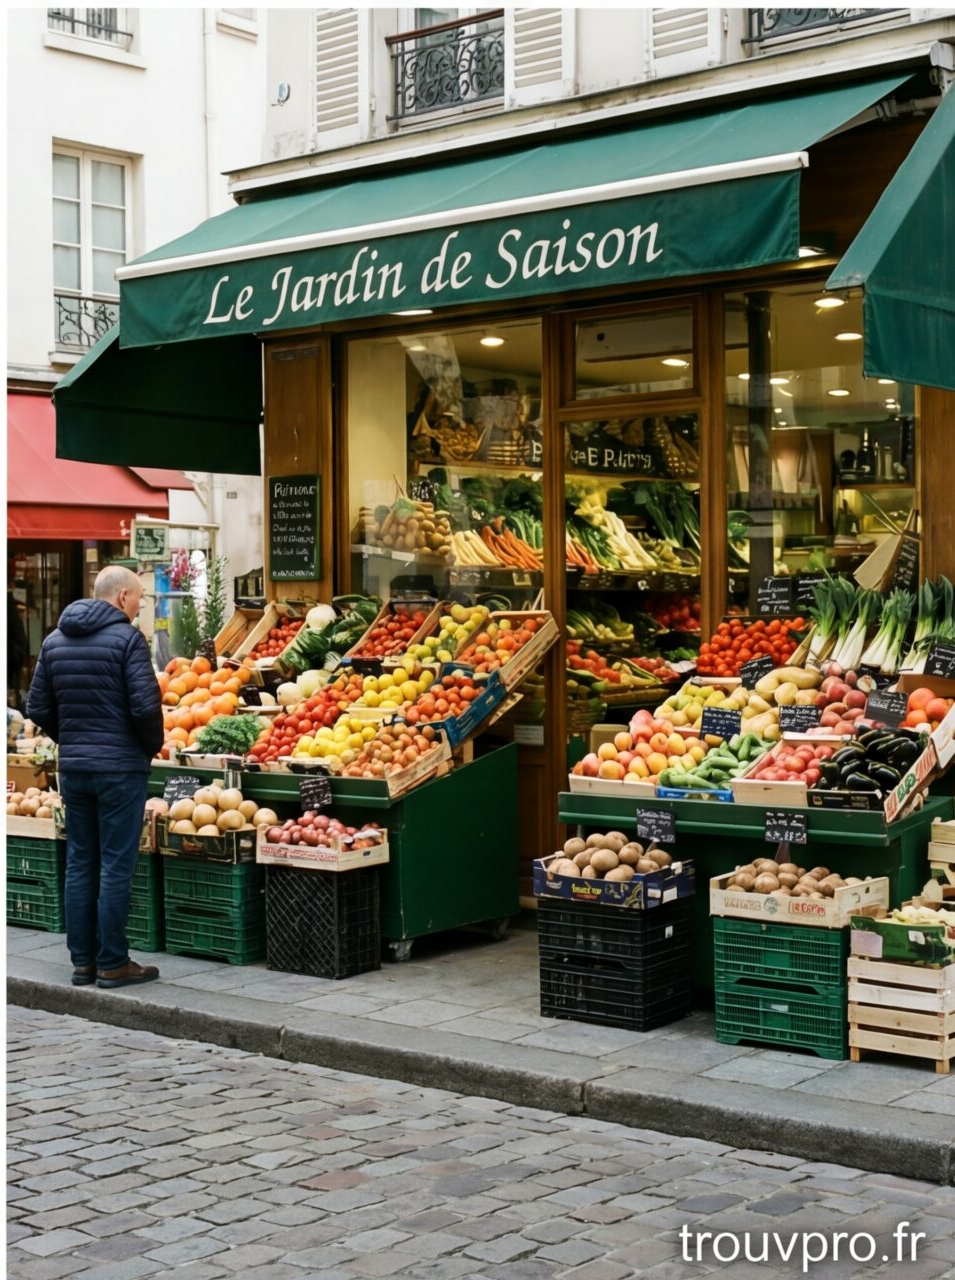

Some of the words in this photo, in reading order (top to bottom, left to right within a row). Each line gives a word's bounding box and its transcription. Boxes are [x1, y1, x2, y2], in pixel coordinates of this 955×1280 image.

[203, 275, 254, 324] Le
[262, 246, 407, 326] Jardin
[420, 230, 472, 294] de
[485, 218, 664, 289] Saison
